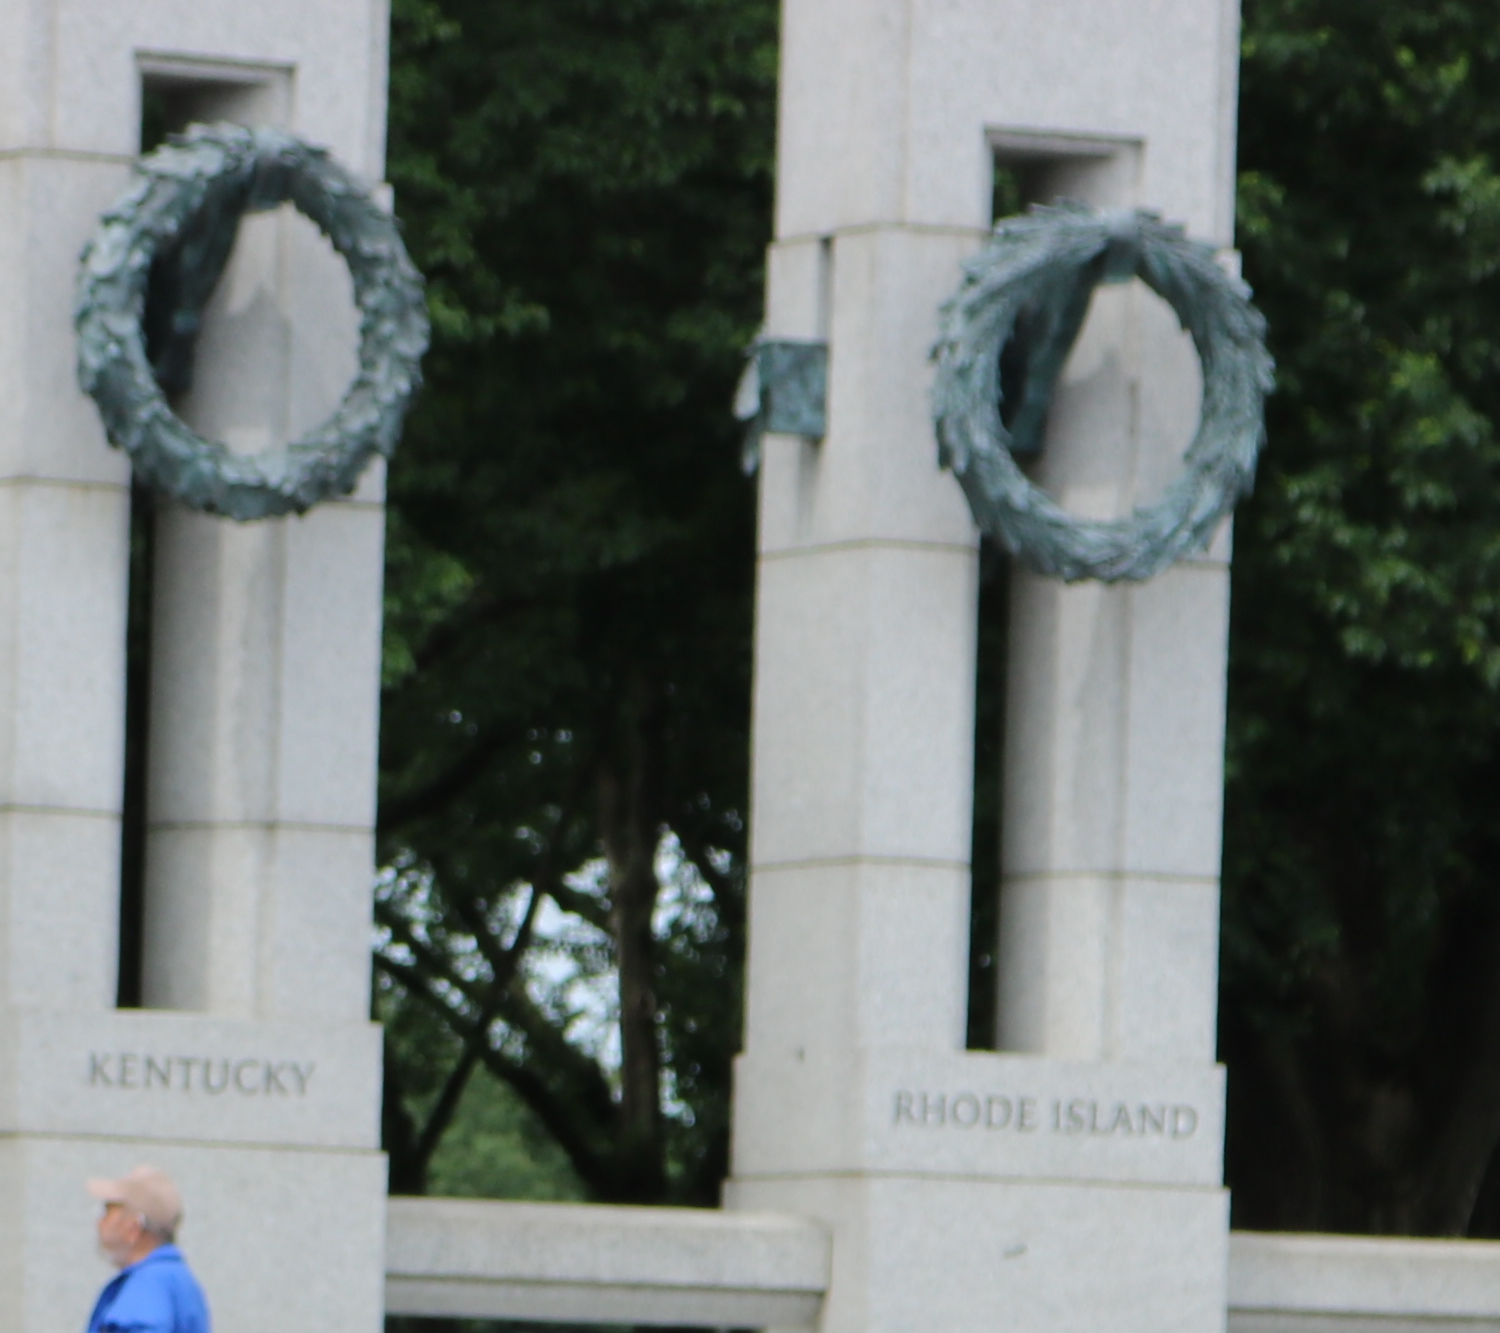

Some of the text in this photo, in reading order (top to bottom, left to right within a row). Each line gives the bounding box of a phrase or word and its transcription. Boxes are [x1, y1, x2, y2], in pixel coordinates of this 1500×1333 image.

[87, 1052, 317, 1098] KENTUCKY
[890, 1090, 1199, 1140] RHODE ISLAND
